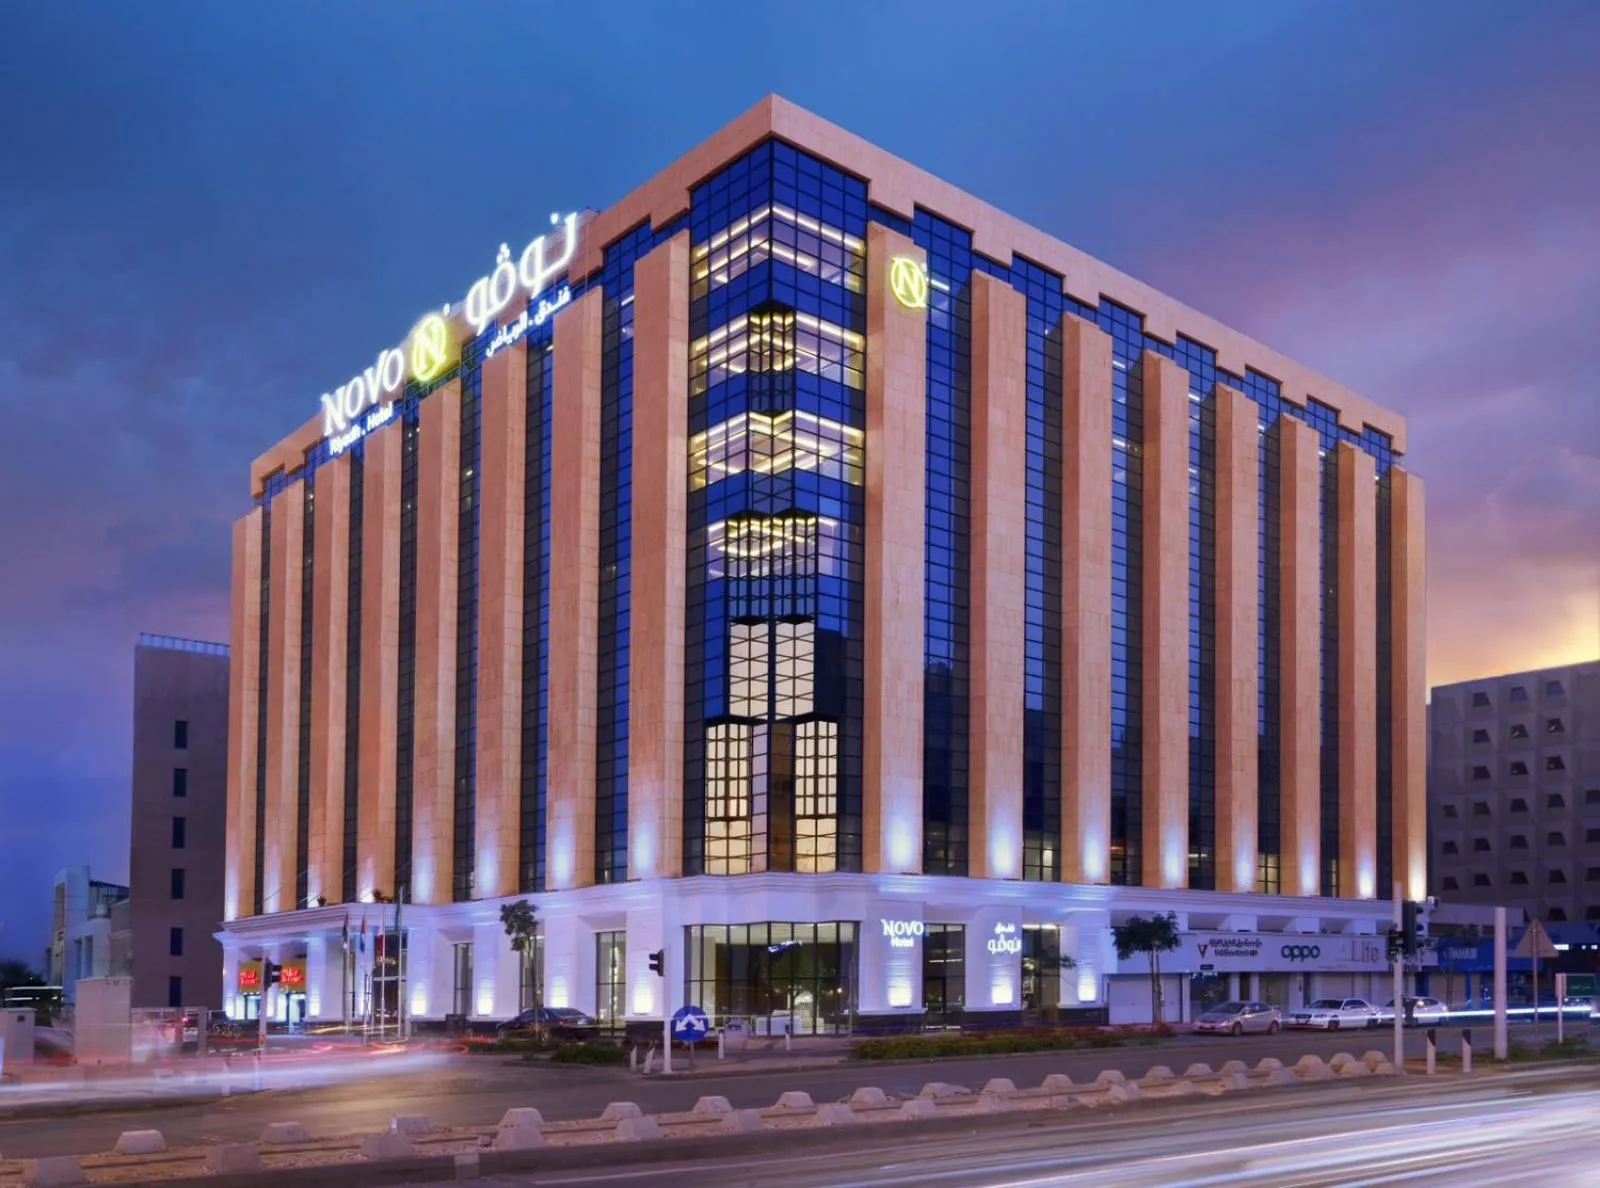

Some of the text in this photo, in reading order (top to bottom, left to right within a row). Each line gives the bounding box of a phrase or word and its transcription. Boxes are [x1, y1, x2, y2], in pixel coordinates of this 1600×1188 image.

[320, 346, 404, 436] NOVO
[367, 401, 393, 432] Hotel
[880, 919, 924, 936] NOVO
[890, 935, 915, 948] Hotel
